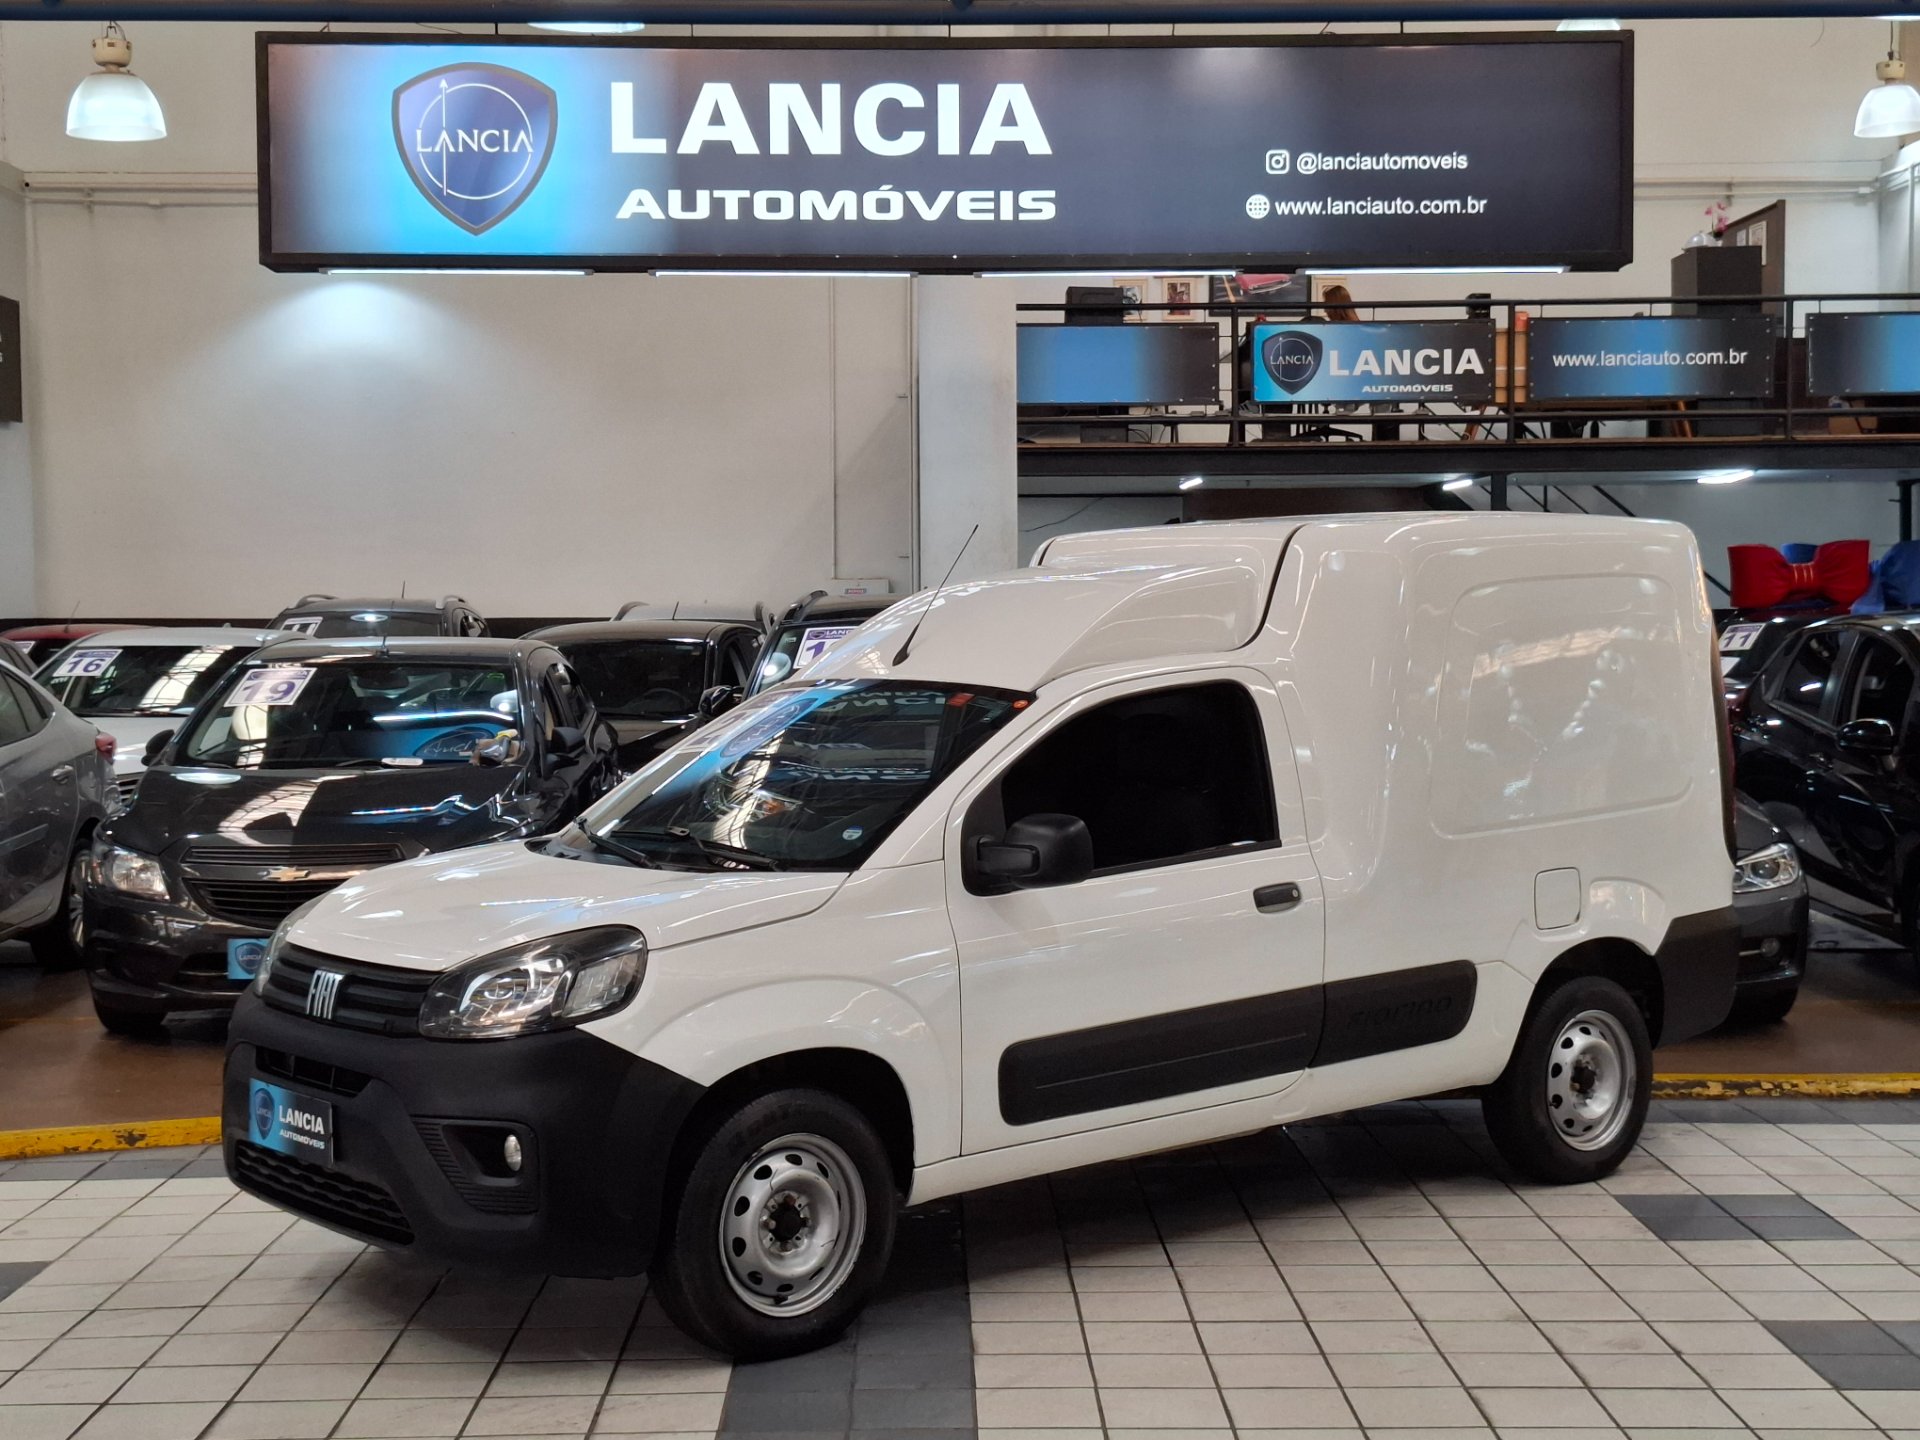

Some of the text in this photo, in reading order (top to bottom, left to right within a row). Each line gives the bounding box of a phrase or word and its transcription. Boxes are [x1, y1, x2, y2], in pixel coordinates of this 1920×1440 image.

[611, 82, 1053, 157] LANCIA
[416, 129, 534, 153] LANCIA
[1297, 152, 1468, 175] @lanciautomoveis
[615, 184, 1056, 221] AUTOMÓVEIS
[1275, 196, 1488, 216] www.lanciauto.com.br
[1270, 355, 1314, 365] LANCIA
[1329, 348, 1485, 376] LANCIA
[1552, 348, 1748, 367] www.lanciauto.com.br
[1361, 383, 1454, 393] AUTOMÓVEIS
[1723, 632, 1752, 648] 11
[67, 658, 106, 673] 16
[242, 680, 296, 702] 19
[306, 969, 345, 1019] FIAT
[278, 1105, 325, 1135] LANCIA
